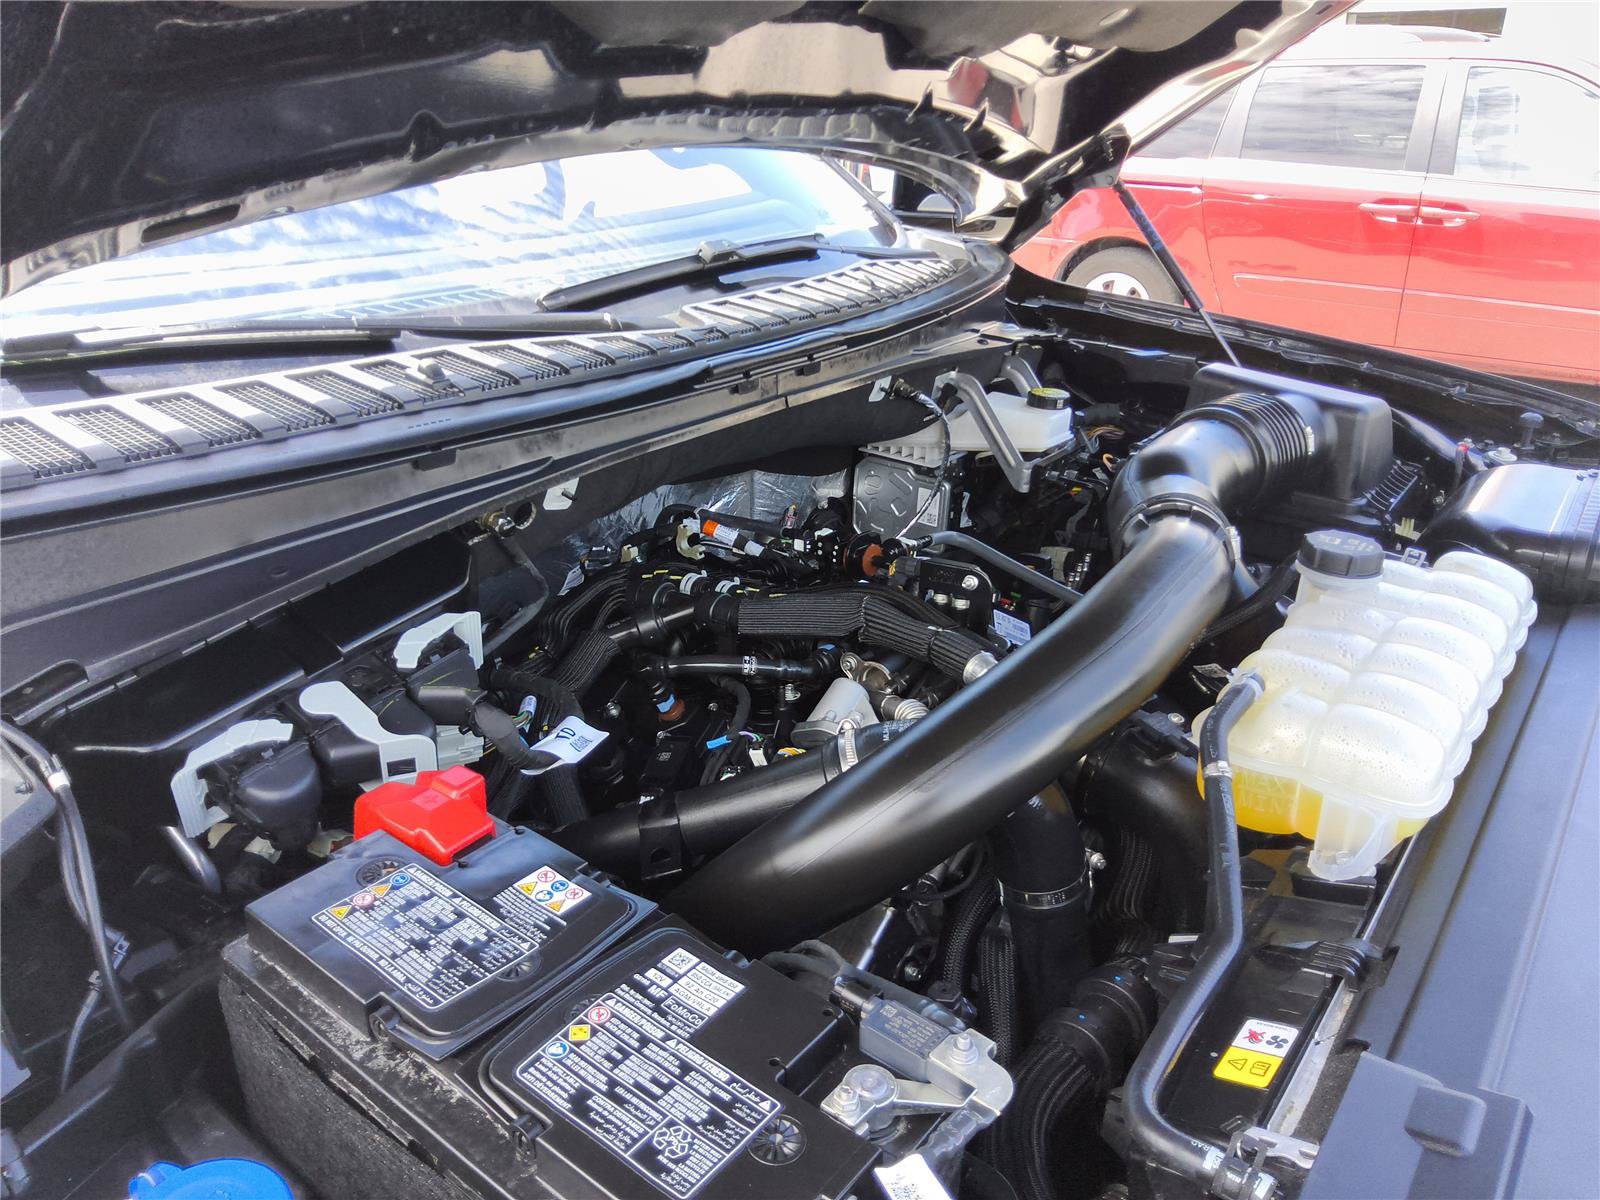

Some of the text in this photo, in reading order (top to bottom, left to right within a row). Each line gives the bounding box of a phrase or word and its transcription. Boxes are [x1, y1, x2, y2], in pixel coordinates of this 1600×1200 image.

[652, 972, 665, 982] 12V
[647, 985, 668, 998] MF
[612, 1003, 665, 1038] DANGER/POISON
[665, 999, 703, 1024] FoMoCo
[674, 1043, 730, 1080] PELIGRO/VENENO
[592, 1095, 614, 1111] CONTRA
